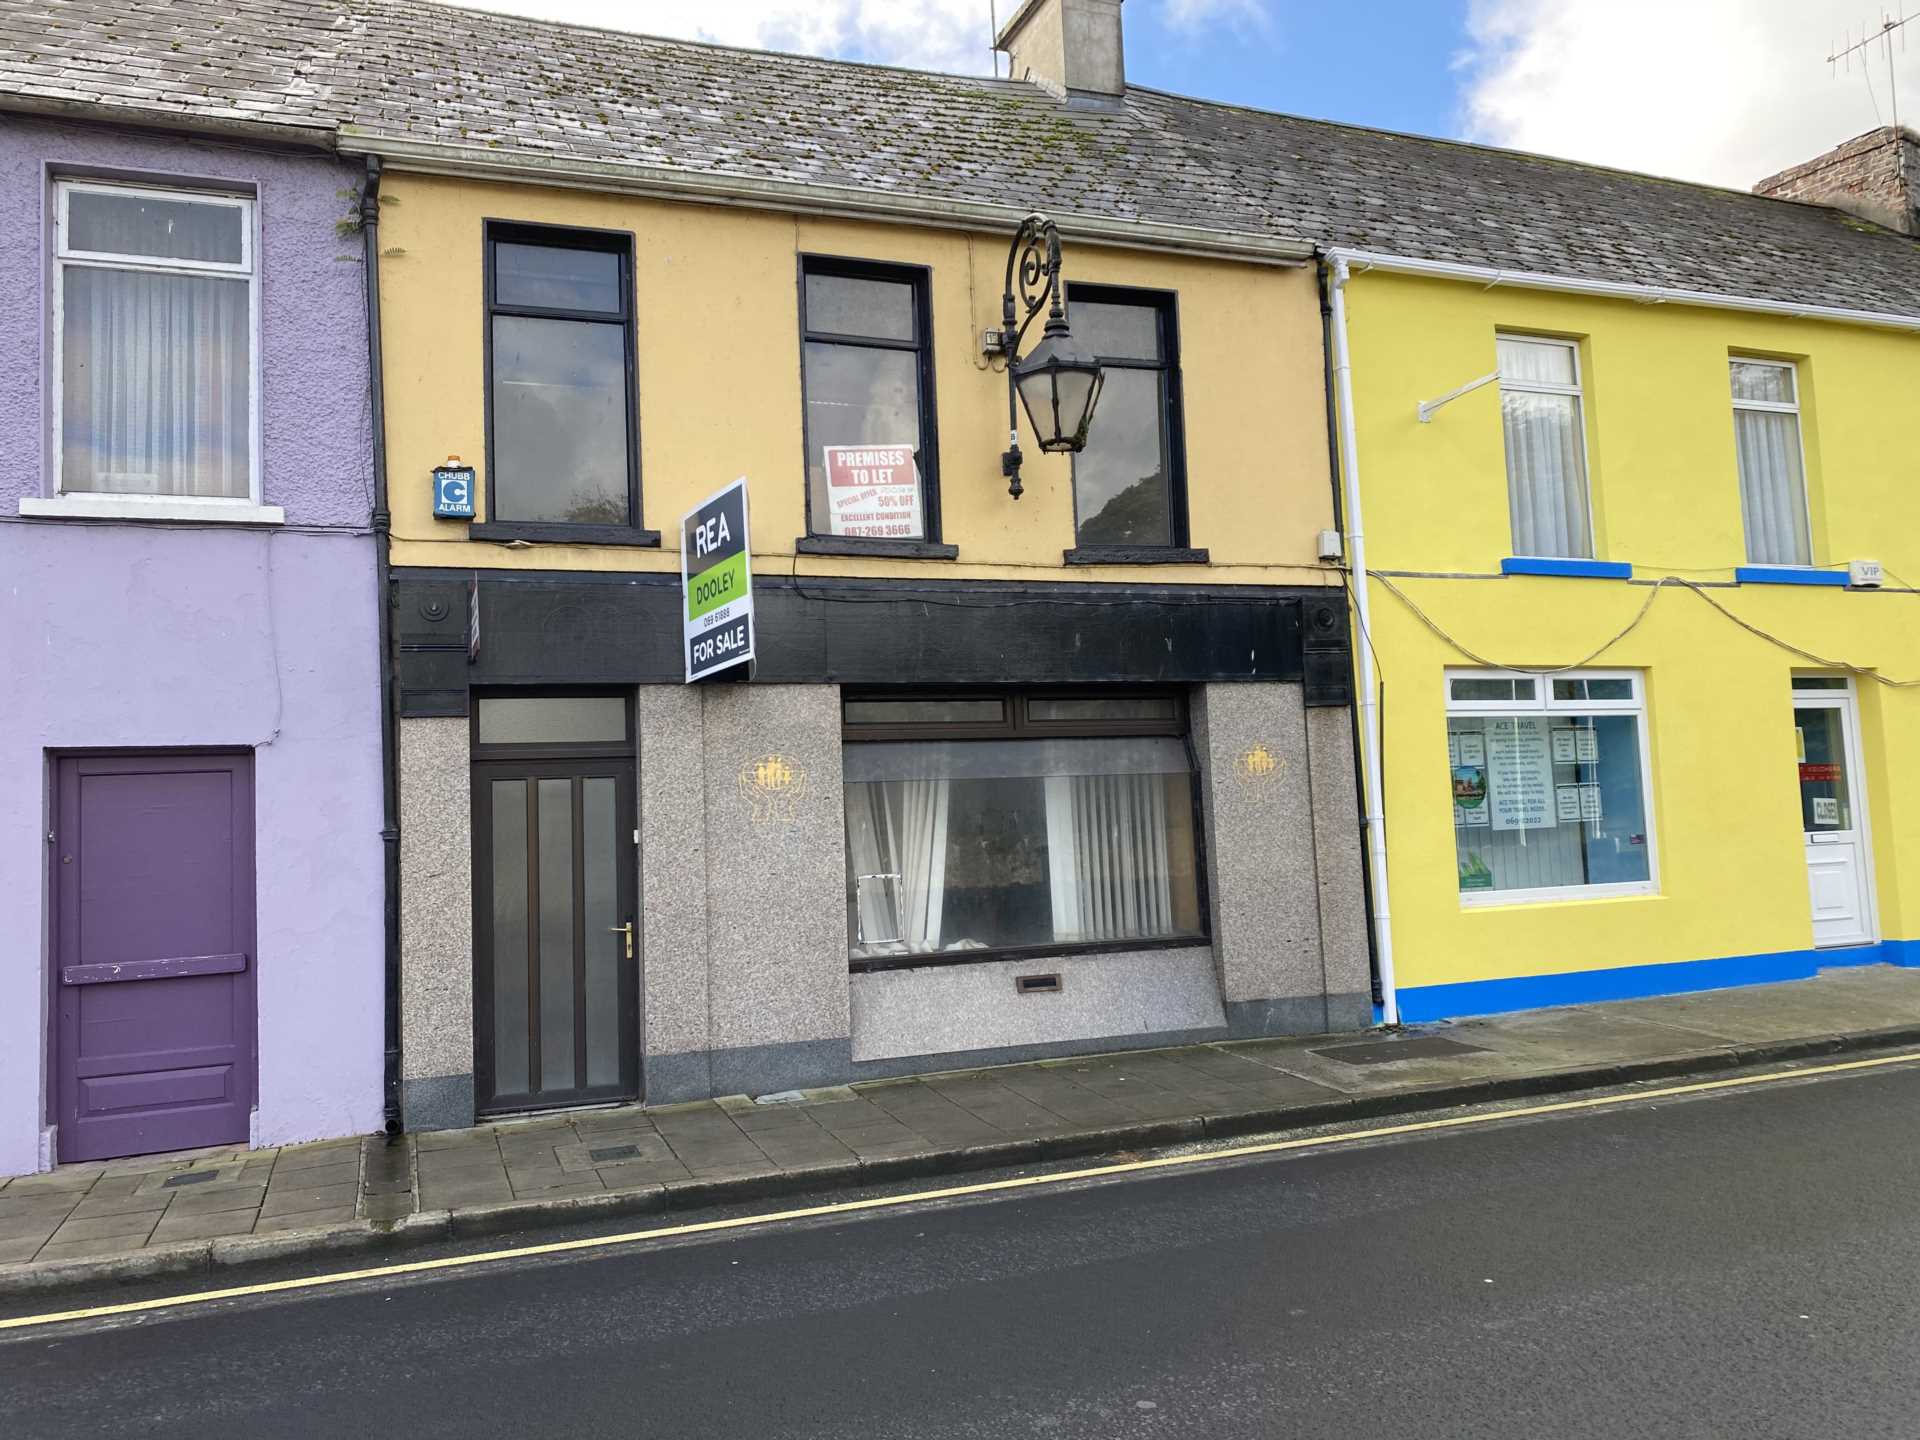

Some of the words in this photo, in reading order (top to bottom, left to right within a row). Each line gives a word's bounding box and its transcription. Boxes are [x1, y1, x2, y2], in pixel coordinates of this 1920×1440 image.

[837, 450, 905, 467] PREMISES
[438, 471, 471, 481] CHUBB
[851, 469, 868, 484] TO
[871, 468, 894, 484] LET
[836, 493, 860, 508] SPECIAL
[861, 488, 878, 501] OFFER
[878, 495, 898, 507] 50%
[899, 494, 914, 506] OFF
[438, 503, 471, 513] ALARM
[841, 512, 875, 522] EXCELLENT
[875, 511, 911, 520] CONDITION
[695, 511, 731, 559] REA
[696, 567, 736, 605] DOOLEY
[693, 638, 714, 665] FOR
[716, 625, 745, 655] SALE
[1496, 721, 1509, 729] ACE
